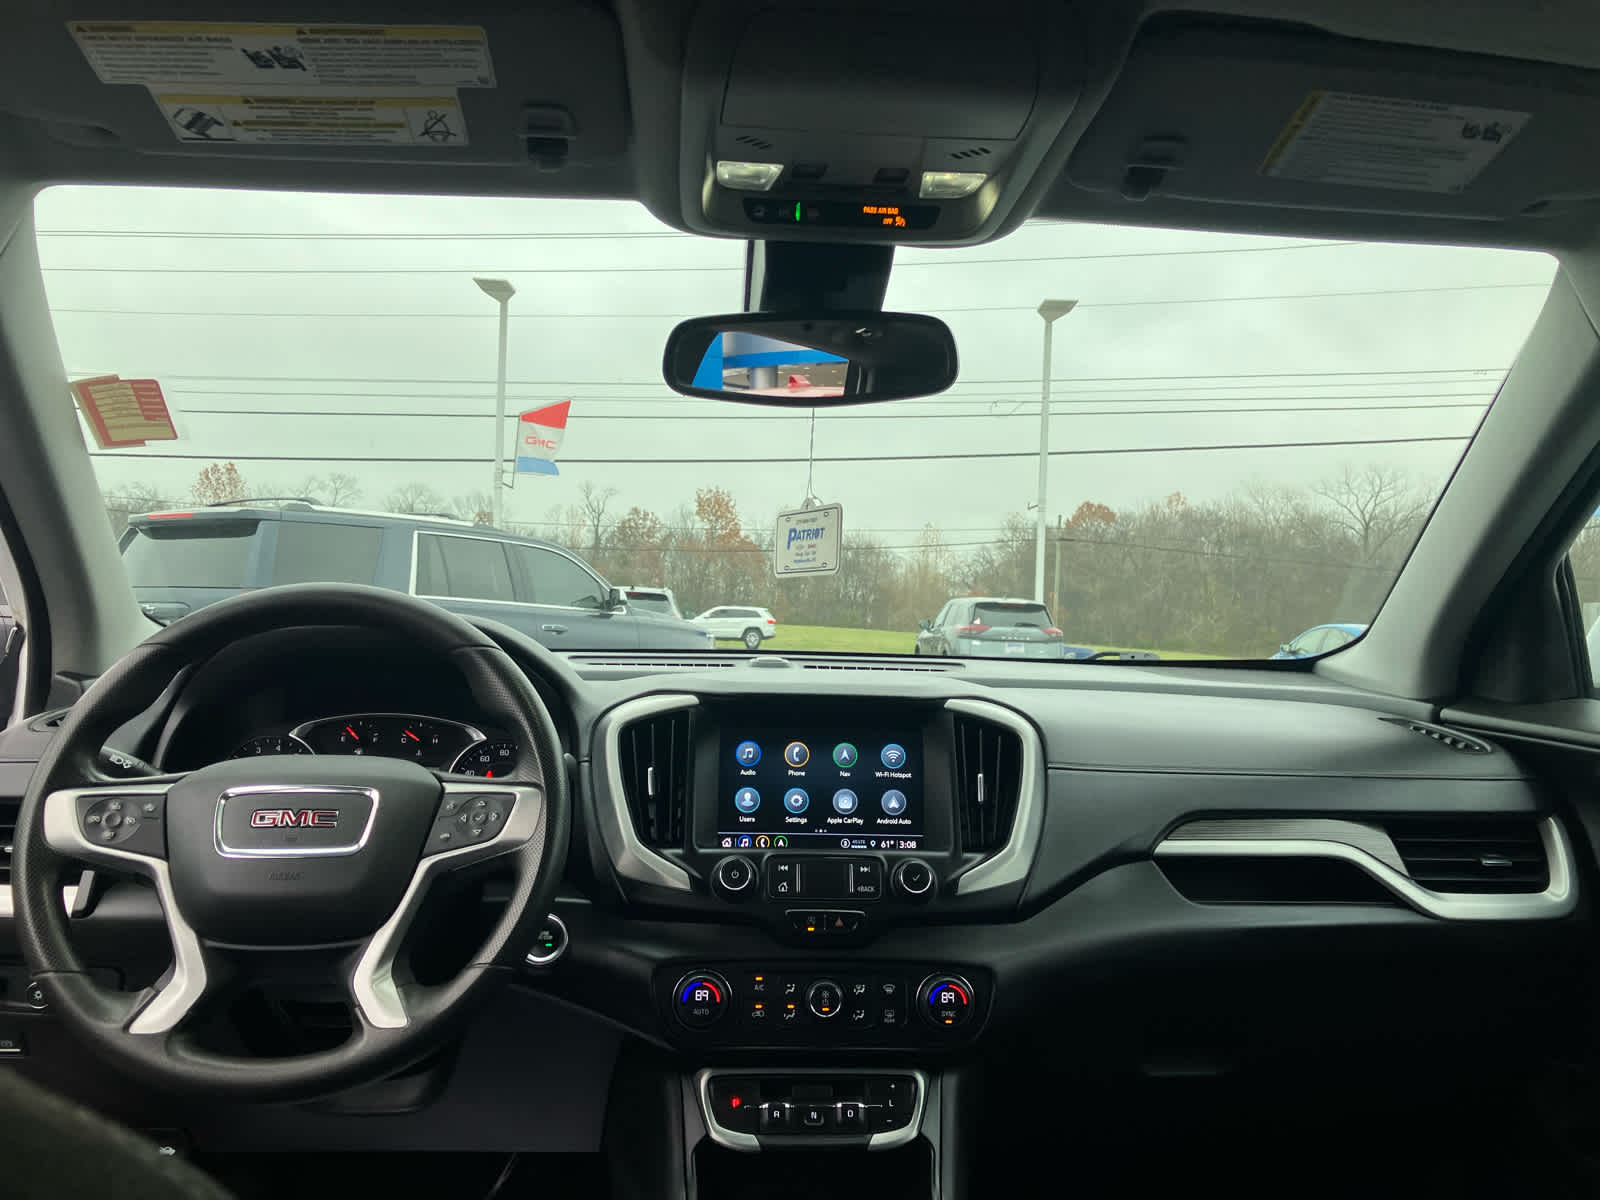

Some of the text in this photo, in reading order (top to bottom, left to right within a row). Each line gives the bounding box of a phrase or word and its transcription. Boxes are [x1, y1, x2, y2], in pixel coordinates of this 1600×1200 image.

[863, 206, 898, 215] PASS AIR BAG
[882, 217, 893, 225] OFF
[524, 435, 557, 450] GMC
[786, 527, 825, 550] PATRIOT
[499, 748, 510, 757] 80
[479, 755, 490, 763] 60
[250, 808, 340, 828] GMC
[785, 816, 808, 824] Settings
[843, 817, 864, 825] CarPlay
[899, 841, 917, 849] 3:08
[695, 990, 709, 1001] 89
[941, 991, 955, 1003] 89
[692, 1008, 710, 1016] AUTO
[773, 1110, 780, 1118] R
[810, 1111, 817, 1119] N
[847, 1110, 854, 1118] D
